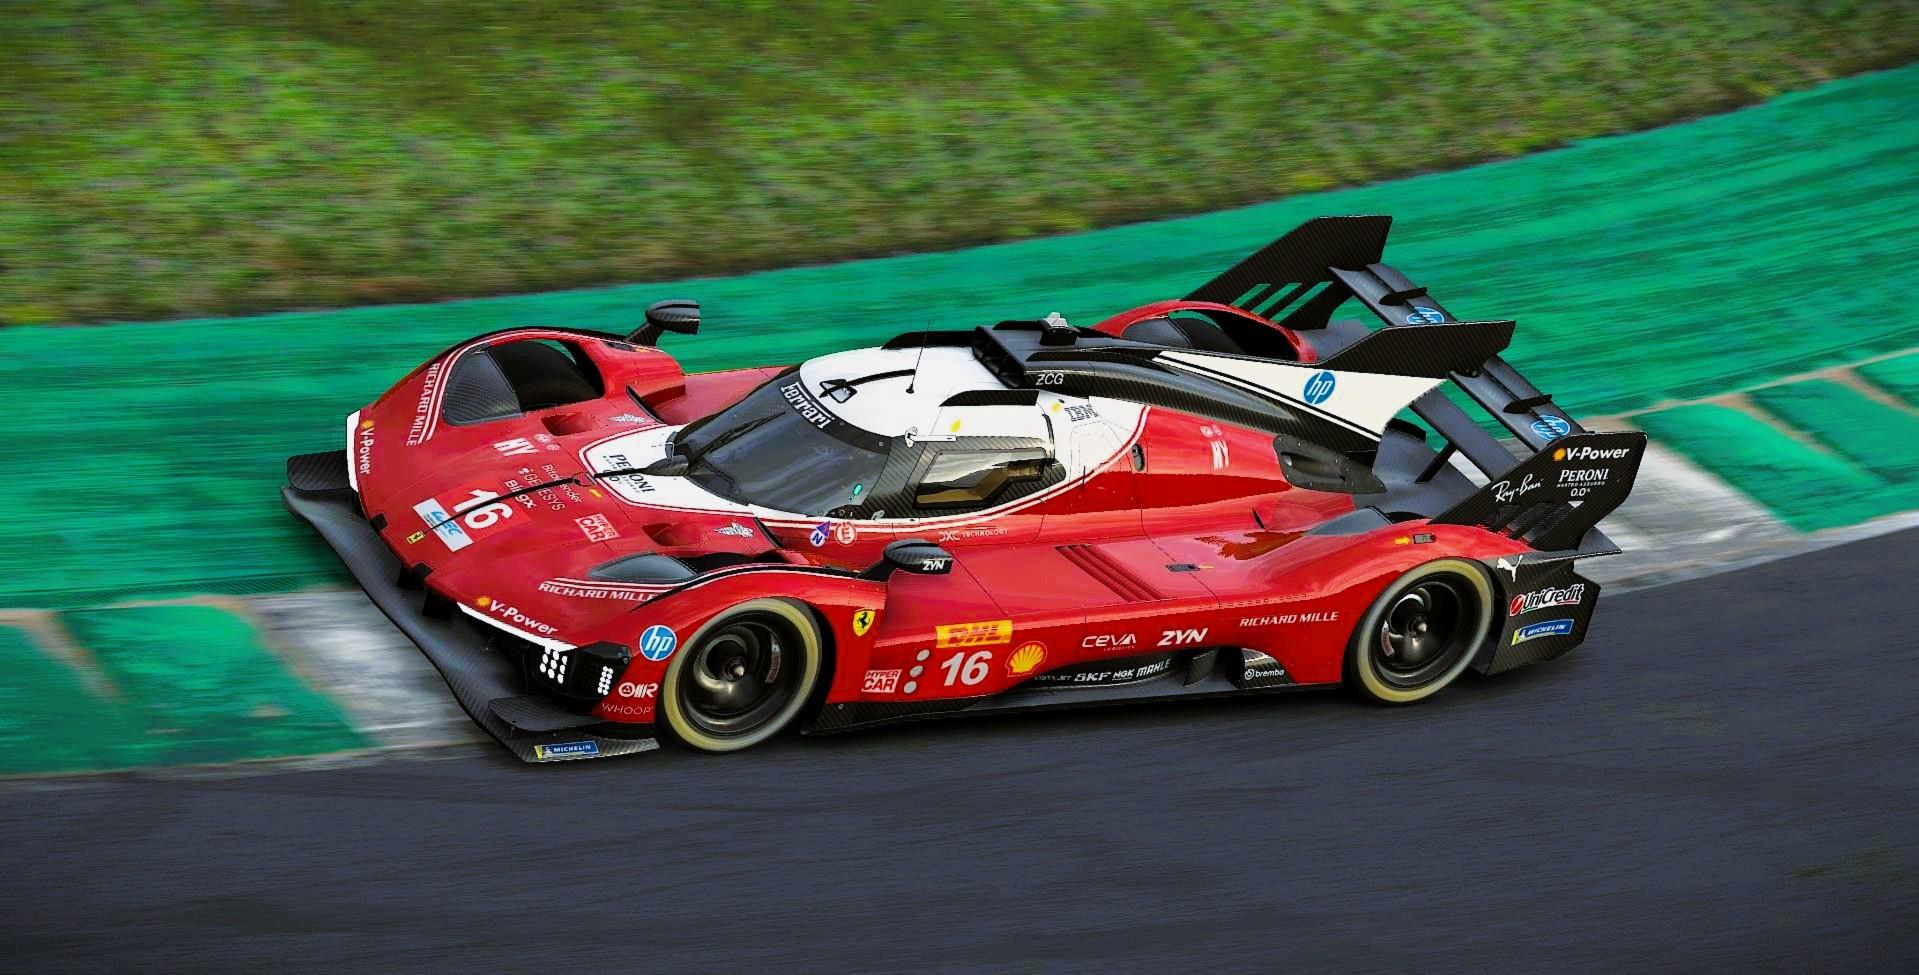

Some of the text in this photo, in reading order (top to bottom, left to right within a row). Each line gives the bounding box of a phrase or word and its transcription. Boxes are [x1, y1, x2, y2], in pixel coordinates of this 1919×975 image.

[1035, 372, 1064, 386] ZCG
[1306, 371, 1334, 404] hp
[406, 362, 440, 447] RICHARD MILLE
[781, 381, 835, 429] Ferrari
[360, 427, 375, 475] V-Power
[1566, 447, 1630, 461] V-Power
[609, 454, 656, 492] PEONI
[1559, 468, 1610, 482] PERONI
[524, 473, 566, 511] GEESYS
[1491, 474, 1544, 503] Ray-Ban
[452, 489, 514, 530] 16
[580, 518, 606, 540] CAR
[923, 558, 945, 571] ZYN
[537, 583, 607, 599] RICHARD
[1524, 584, 1584, 609] UniCredit
[489, 599, 559, 635] V-Power
[1239, 611, 1340, 627] RICHARD MILLE
[1156, 628, 1209, 647] ZYN
[1527, 624, 1567, 636] MICHELIN
[644, 625, 674, 661] hp
[866, 670, 898, 678] HYPER
[940, 650, 993, 687] 16
[1074, 671, 1111, 682] SKF
[1112, 668, 1135, 679] NGK
[1136, 659, 1171, 677] MAHLE
[1255, 668, 1285, 678] brembo
[863, 678, 895, 691] CAR
[602, 702, 652, 715] WHOOP
[553, 744, 592, 754] MICHELIN
